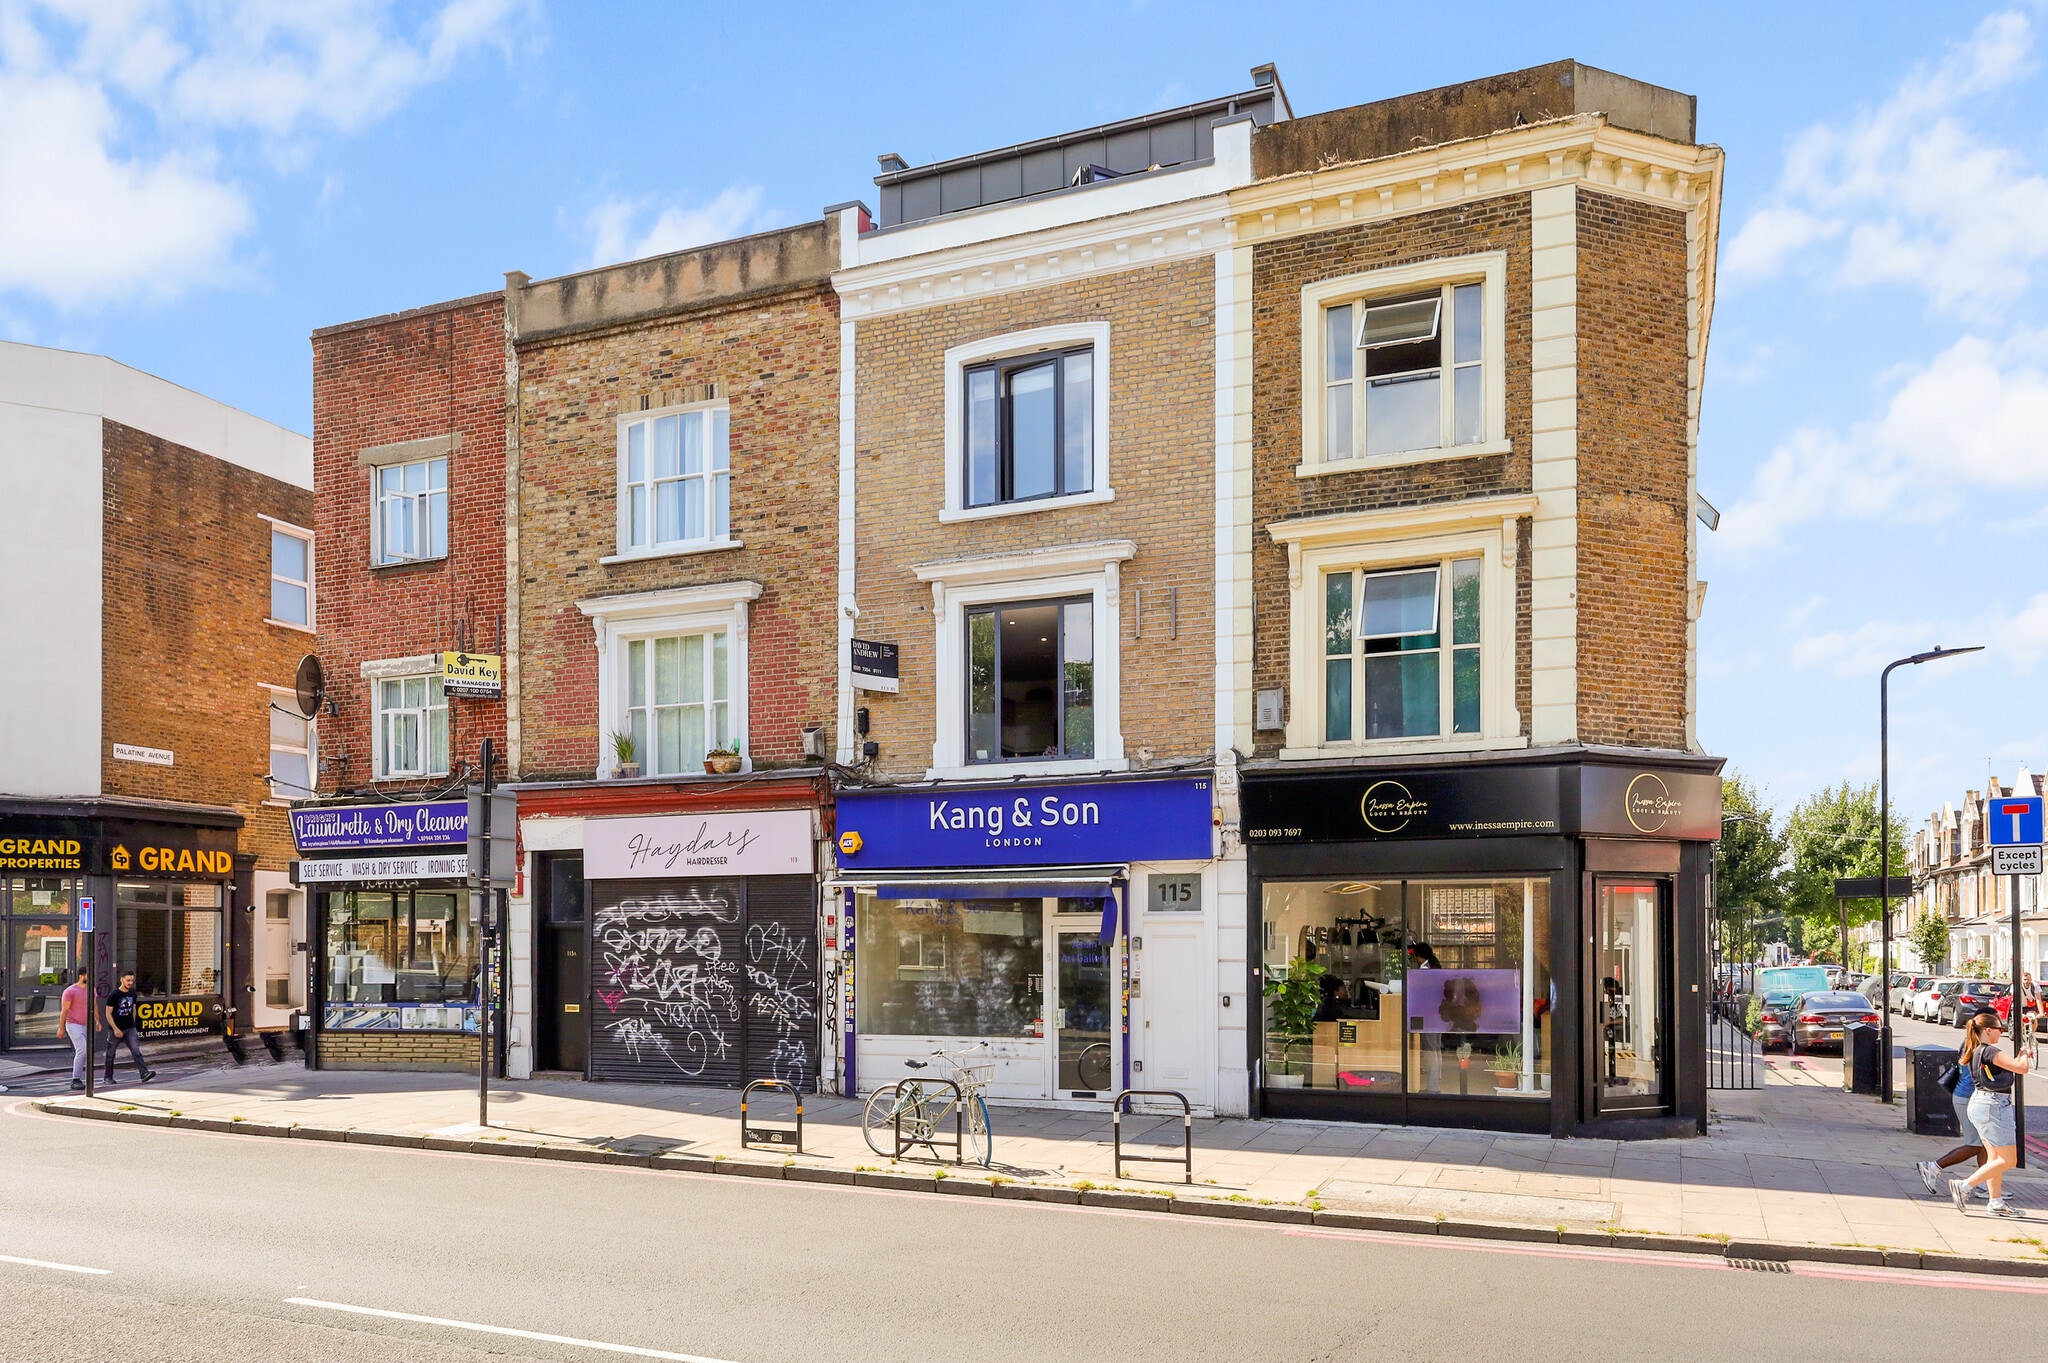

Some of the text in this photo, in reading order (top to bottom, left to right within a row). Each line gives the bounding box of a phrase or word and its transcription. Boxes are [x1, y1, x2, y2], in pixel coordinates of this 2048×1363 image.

[853, 648, 879, 658] ANDREW
[447, 663, 498, 680] David Key
[115, 747, 171, 761] PALATINE AVENUE
[1194, 782, 1207, 790] 115
[1368, 798, 1428, 814] Inessa Empire
[304, 812, 336, 824] BRIGHT
[929, 796, 1099, 836] Kang & Son
[297, 807, 468, 841] Laundrette & Dry Cleaner
[1449, 819, 1555, 831] www.inessaempire.com
[1249, 828, 1302, 838] 0203 093 7697
[0, 839, 81, 855] GRAND
[628, 821, 760, 870] Haydars
[985, 837, 1042, 848] LONDON
[114, 852, 128, 867] GP
[139, 847, 232, 873] GRAND
[686, 856, 728, 866] HAIRDRESSER
[1998, 850, 2037, 860] Except
[0, 858, 81, 869] PROPERTIES
[304, 864, 317, 878] SELF
[319, 863, 342, 877] SERVICE
[352, 862, 370, 876] WASH
[372, 863, 377, 875] &
[379, 861, 391, 875] DRY
[393, 860, 418, 874] SERVICE
[428, 859, 456, 874] IRONING
[2000, 861, 2035, 871] cycles
[1158, 883, 1192, 902] 115
[905, 899, 944, 917] Kang
[963, 899, 992, 915] Son
[1072, 939, 1097, 949] Asian
[1062, 954, 1109, 965] Art Gallery
[138, 1001, 203, 1019] GRAND
[142, 1017, 199, 1029] PROPERTIES
[145, 1030, 169, 1038] LETTINGS
[174, 1027, 209, 1036] MANAGEMENT
